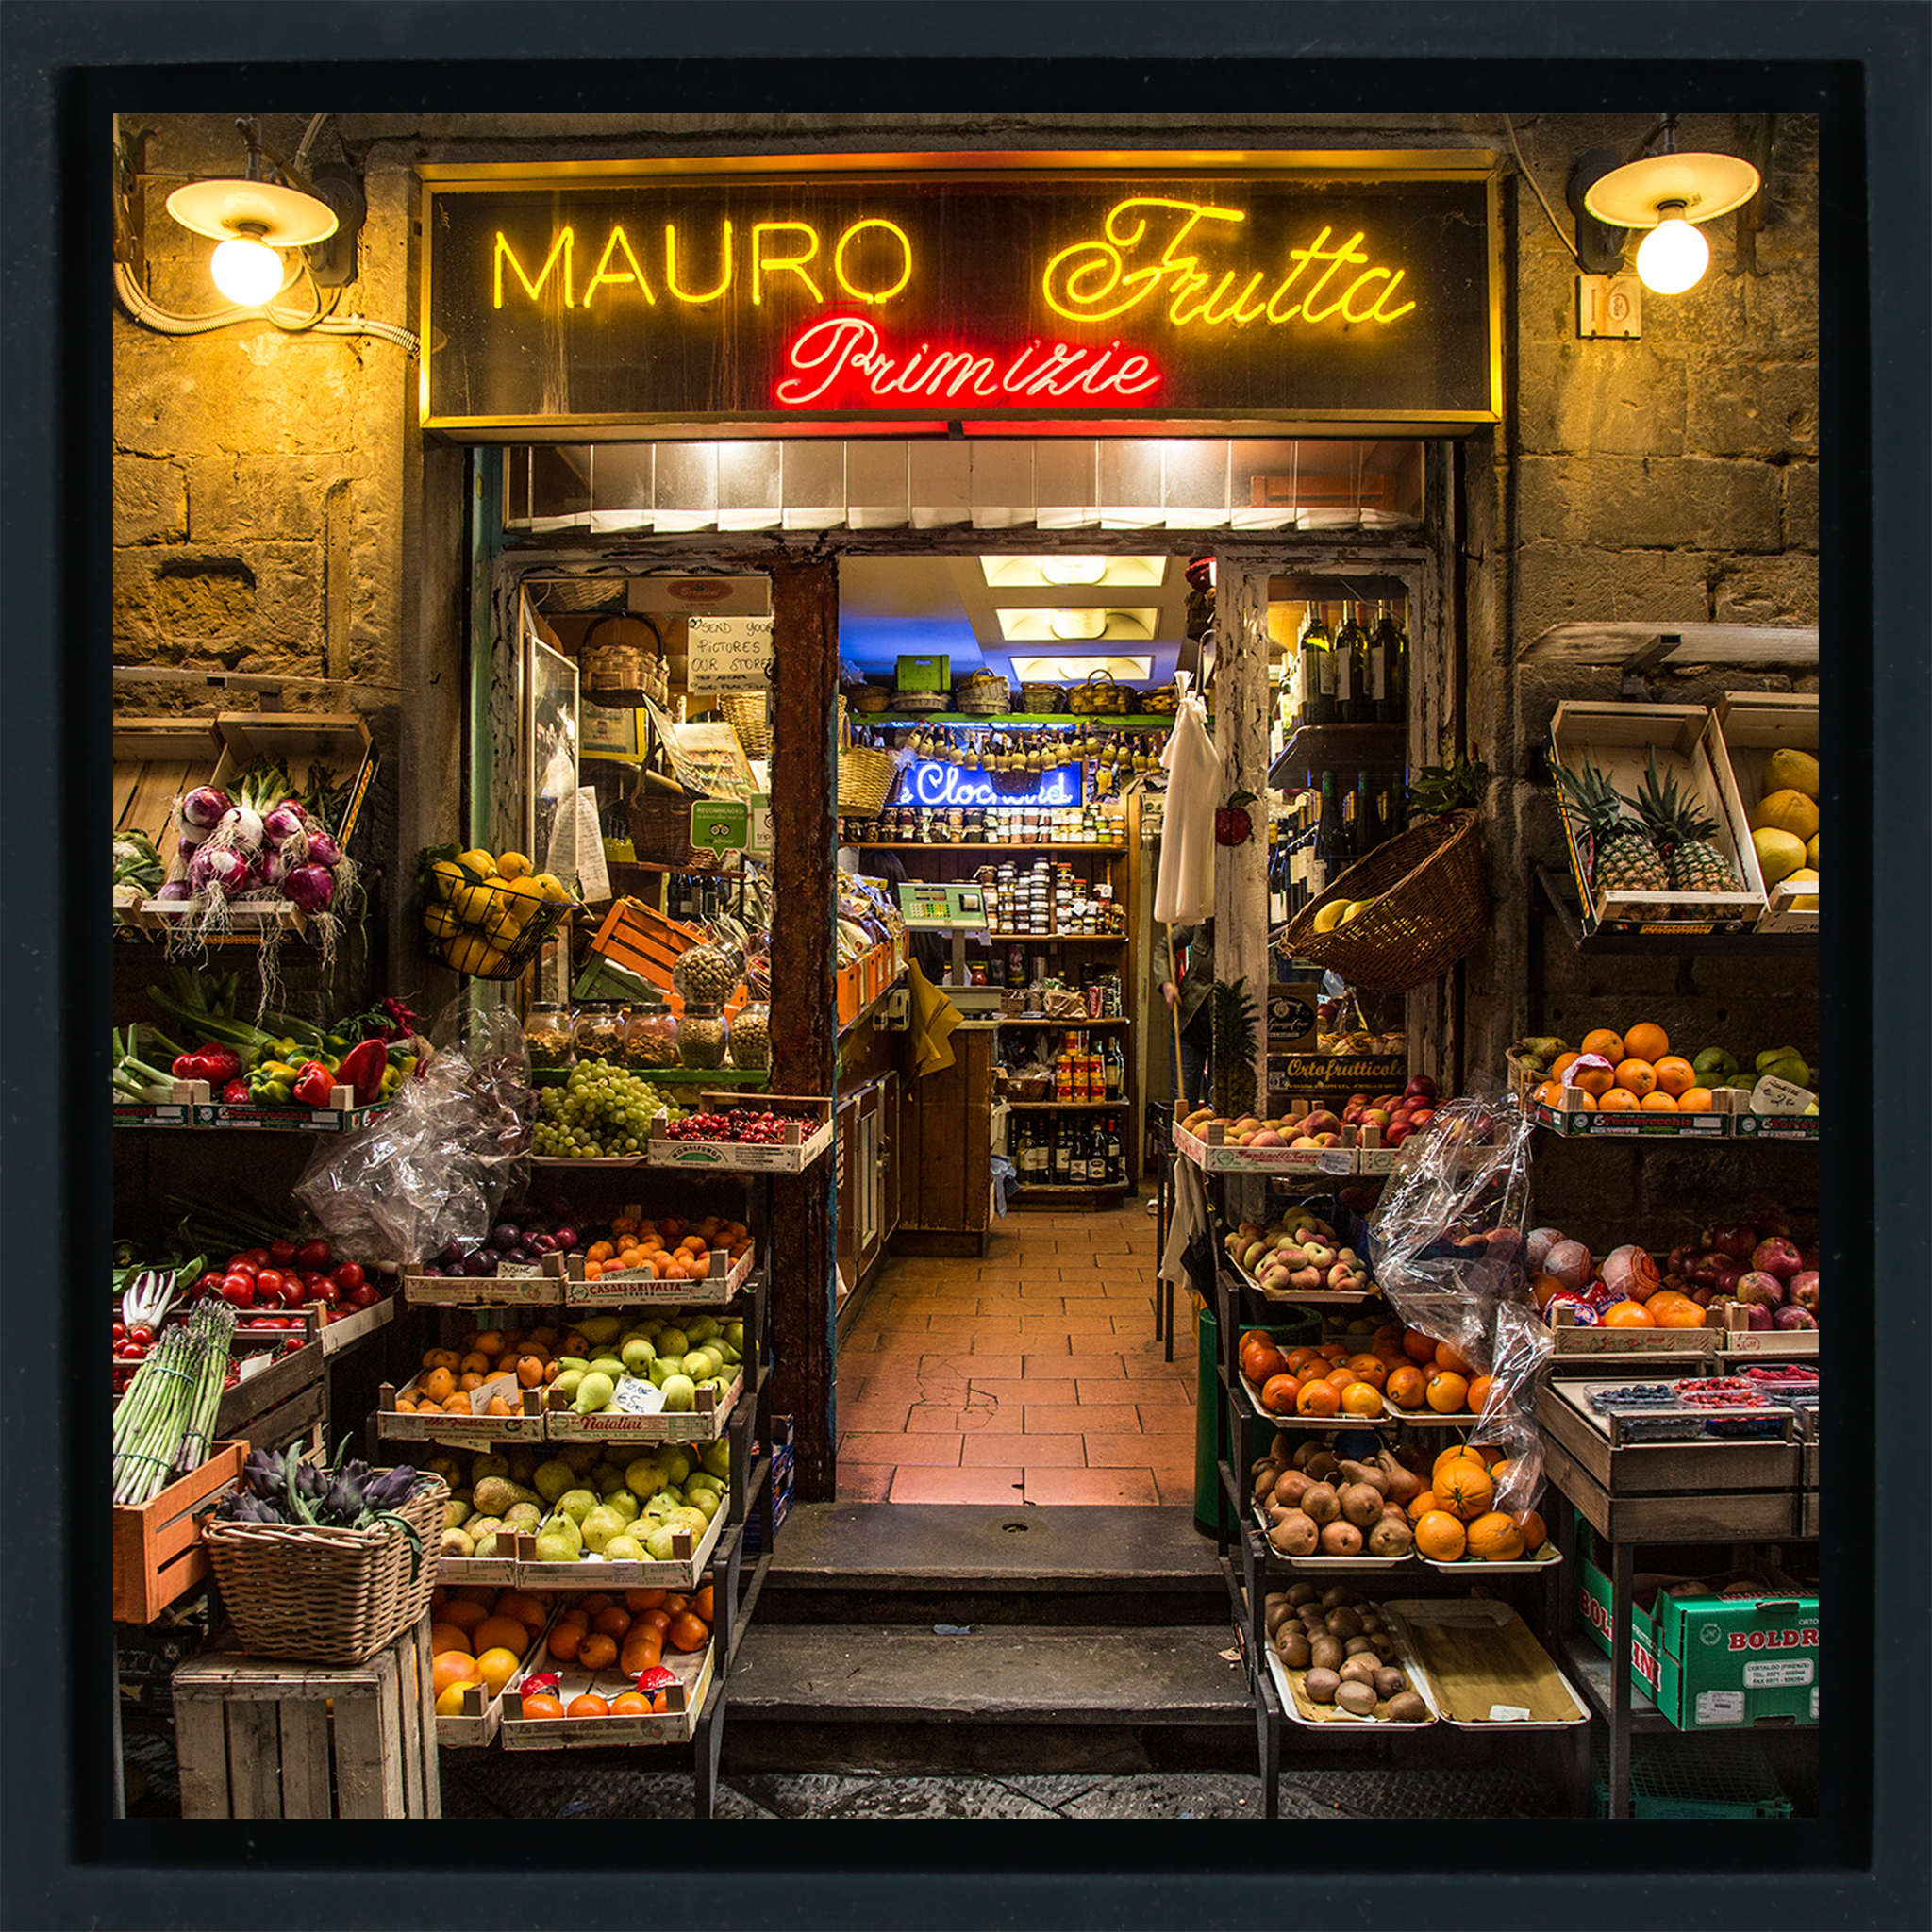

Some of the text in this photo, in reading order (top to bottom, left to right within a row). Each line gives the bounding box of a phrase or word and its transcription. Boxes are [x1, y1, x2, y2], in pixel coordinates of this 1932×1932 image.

[492, 196, 1417, 325] MAURO Frutta
[1591, 280, 1631, 323] 16
[776, 316, 1161, 406] Primizie
[701, 622, 732, 634] SEND
[691, 658, 718, 672] OUR
[696, 807, 750, 815] RECOMMENDED
[1604, 1115, 1693, 1126] Torrevecchia
[590, 1285, 628, 1295] CASALI
[638, 1282, 682, 1292] RIVALTA
[580, 1416, 643, 1431] Natalini
[1727, 1628, 1819, 1652] BOLDR
